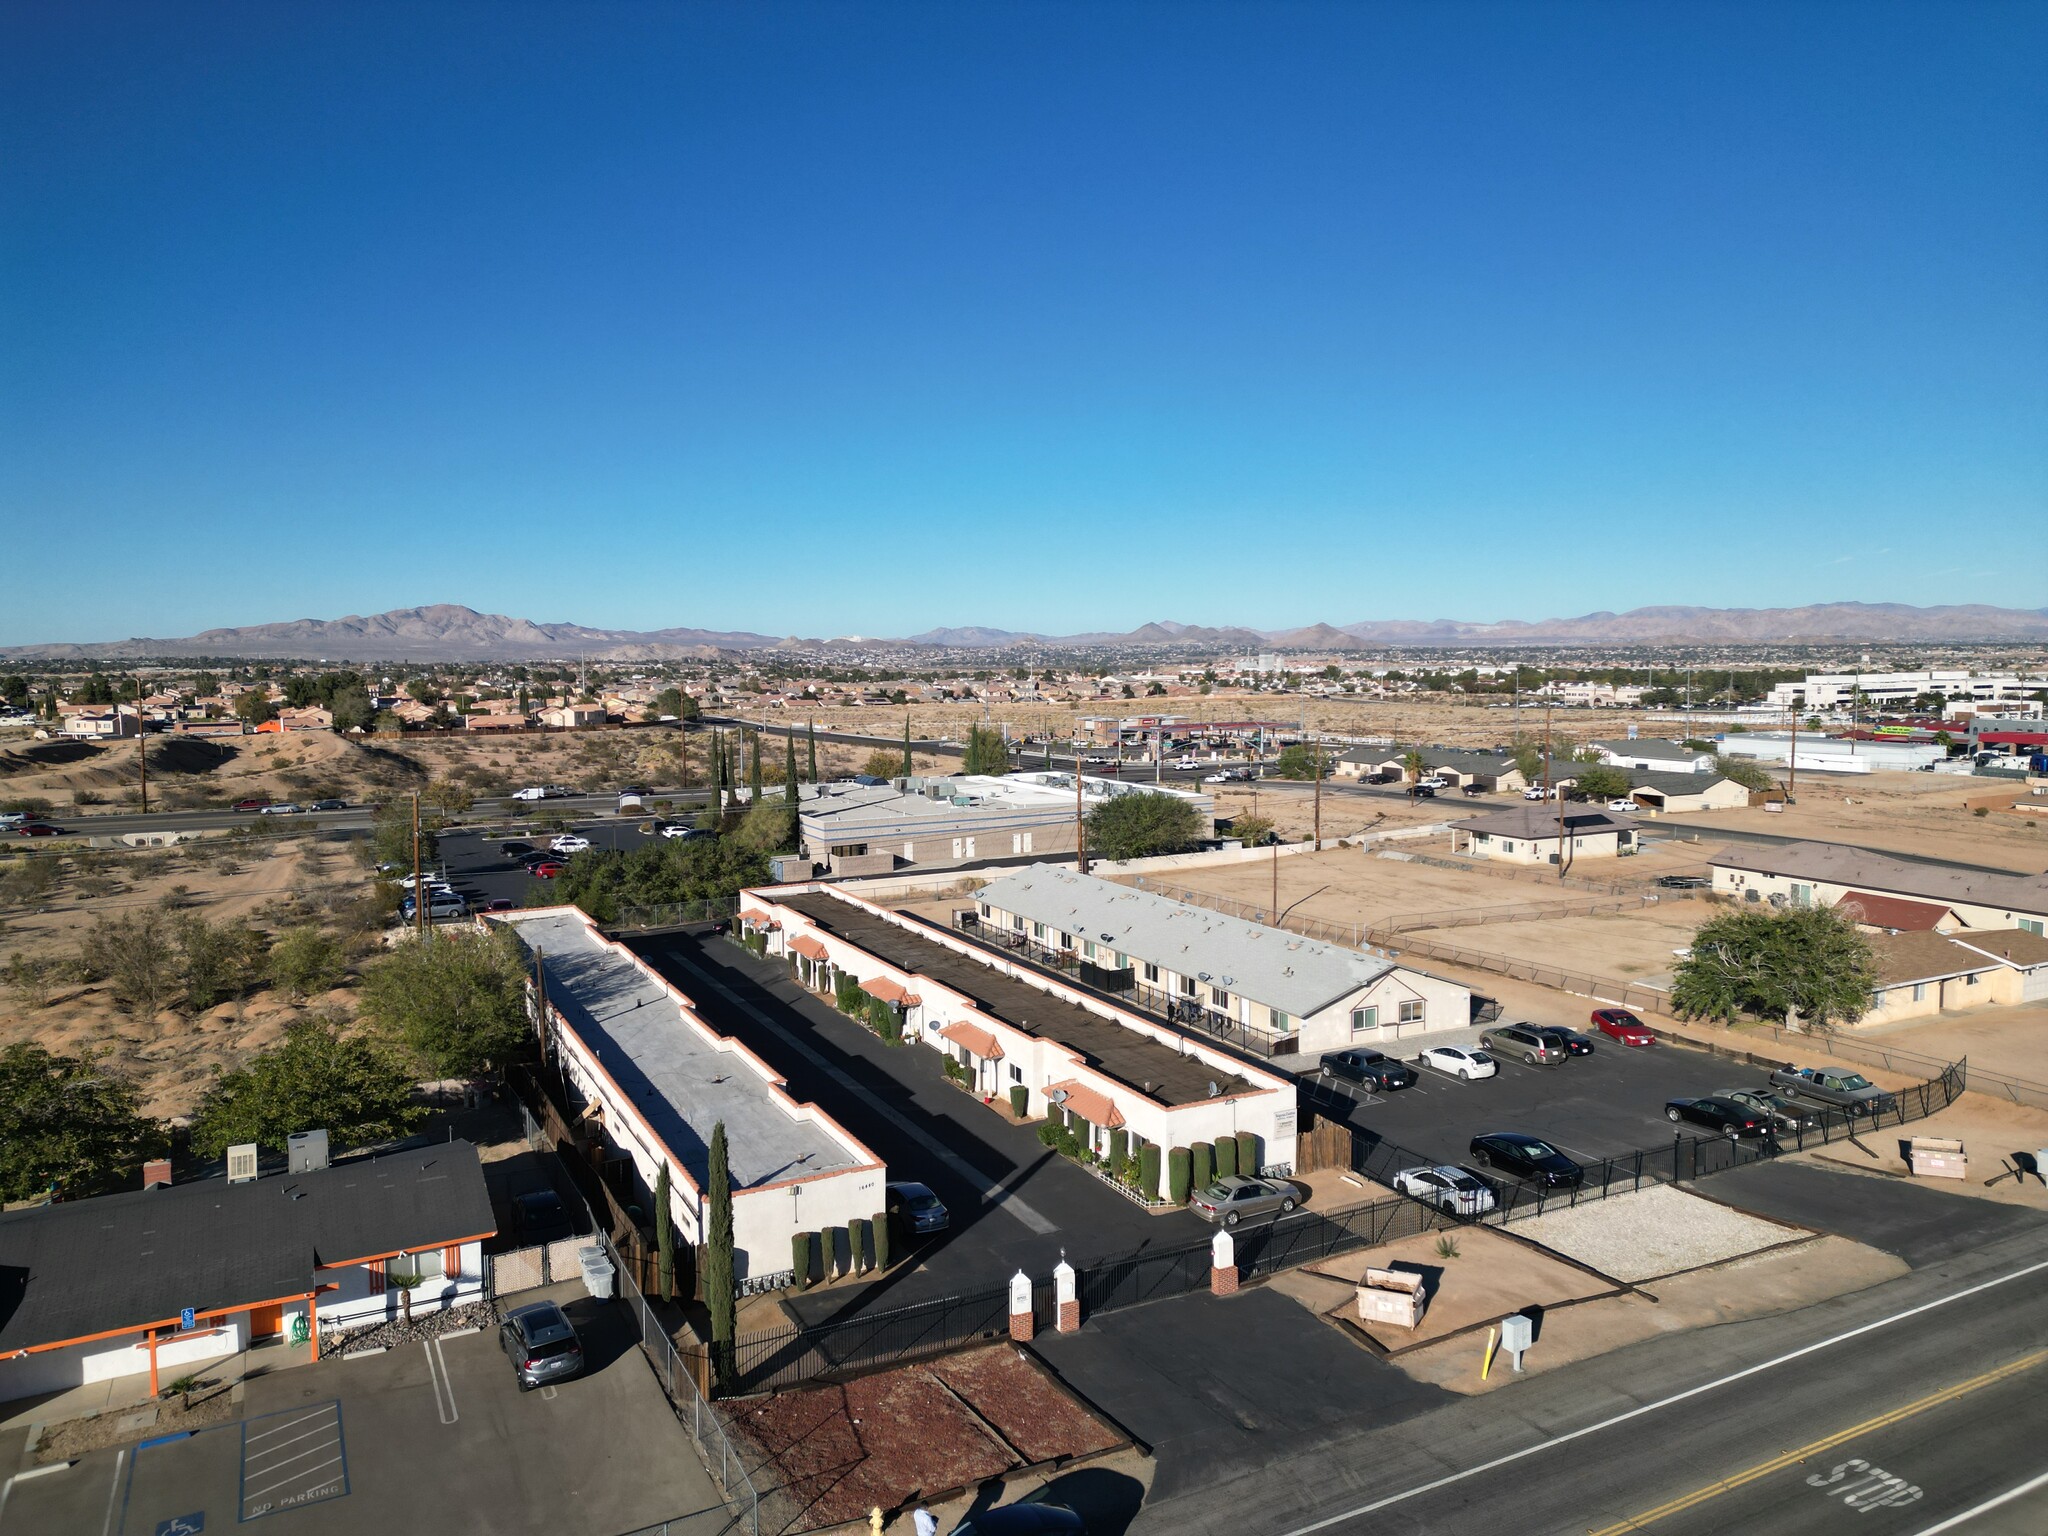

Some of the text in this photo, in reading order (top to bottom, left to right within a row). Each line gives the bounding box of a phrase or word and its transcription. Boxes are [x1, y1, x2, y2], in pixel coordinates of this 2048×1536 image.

[252, 1485, 339, 1514] NO PARKING
[1806, 1459, 1923, 1513] STOP
